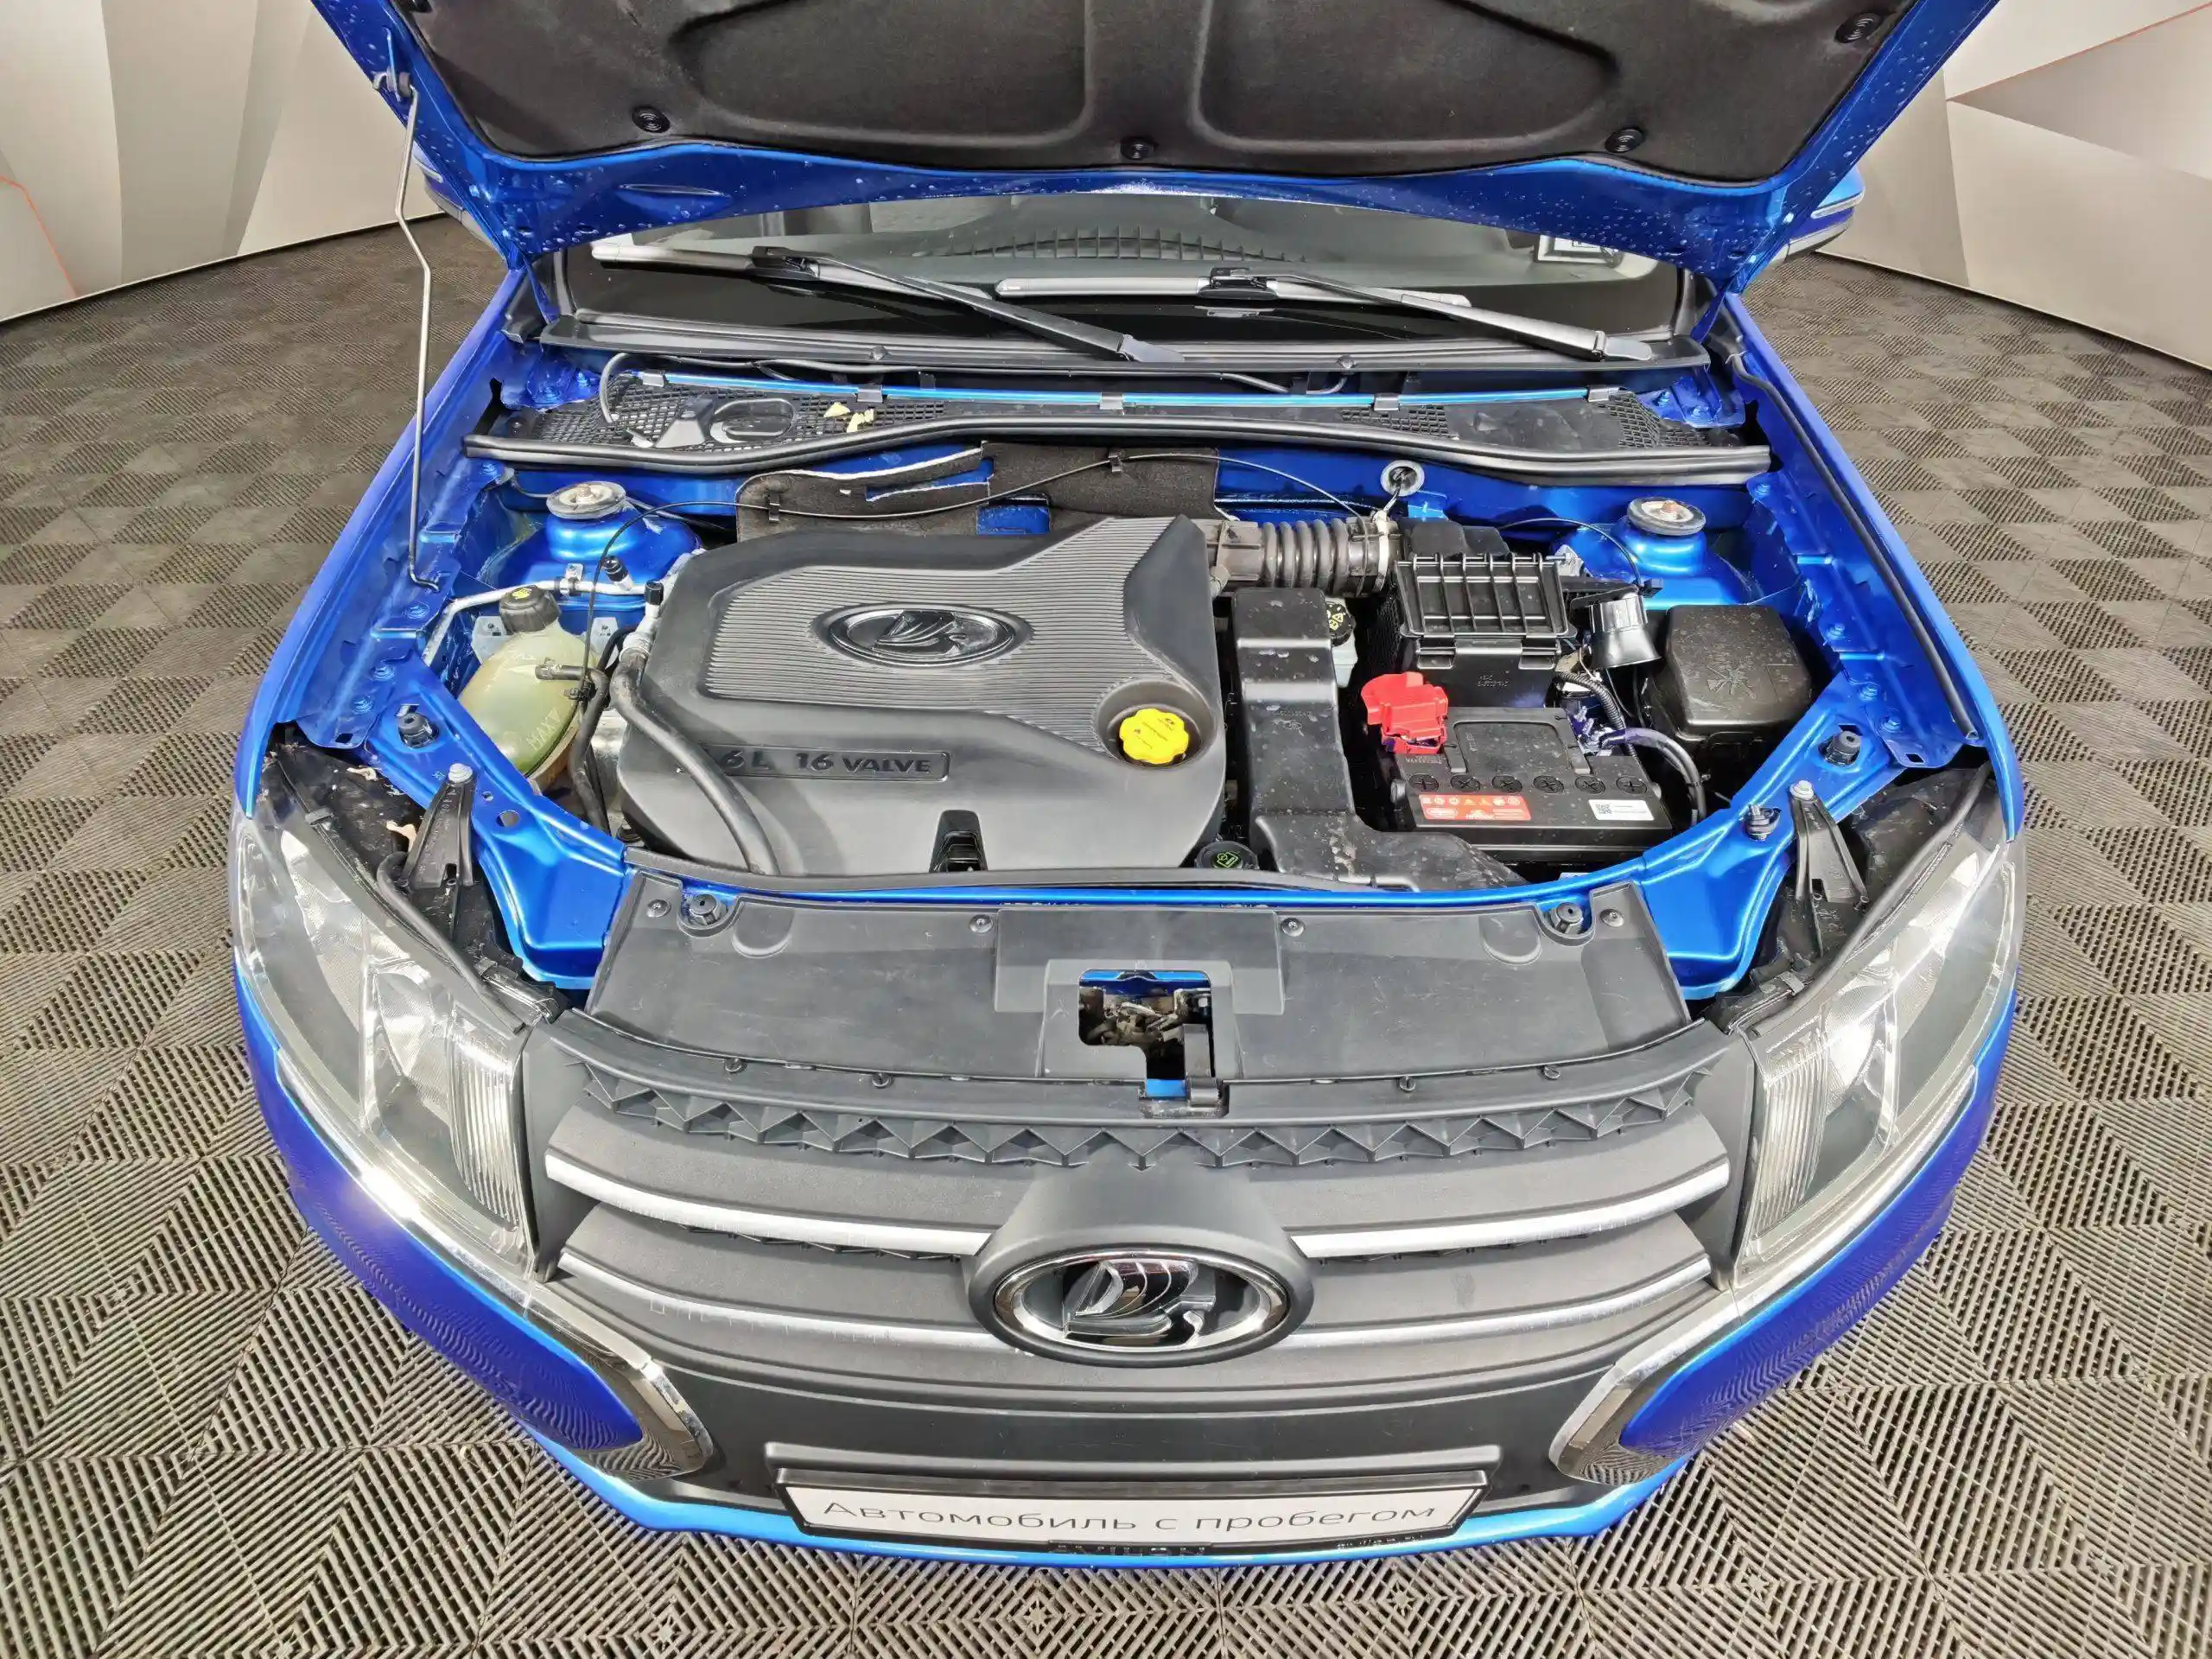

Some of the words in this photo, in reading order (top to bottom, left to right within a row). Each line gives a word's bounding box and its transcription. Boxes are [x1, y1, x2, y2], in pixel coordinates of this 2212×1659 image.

[795, 752, 834, 772] 16
[842, 756, 931, 773] VALVE
[823, 1502, 1136, 1529] Автомобиль
[1154, 1517, 1179, 1530] с
[1195, 1507, 1435, 1533] пробегом
